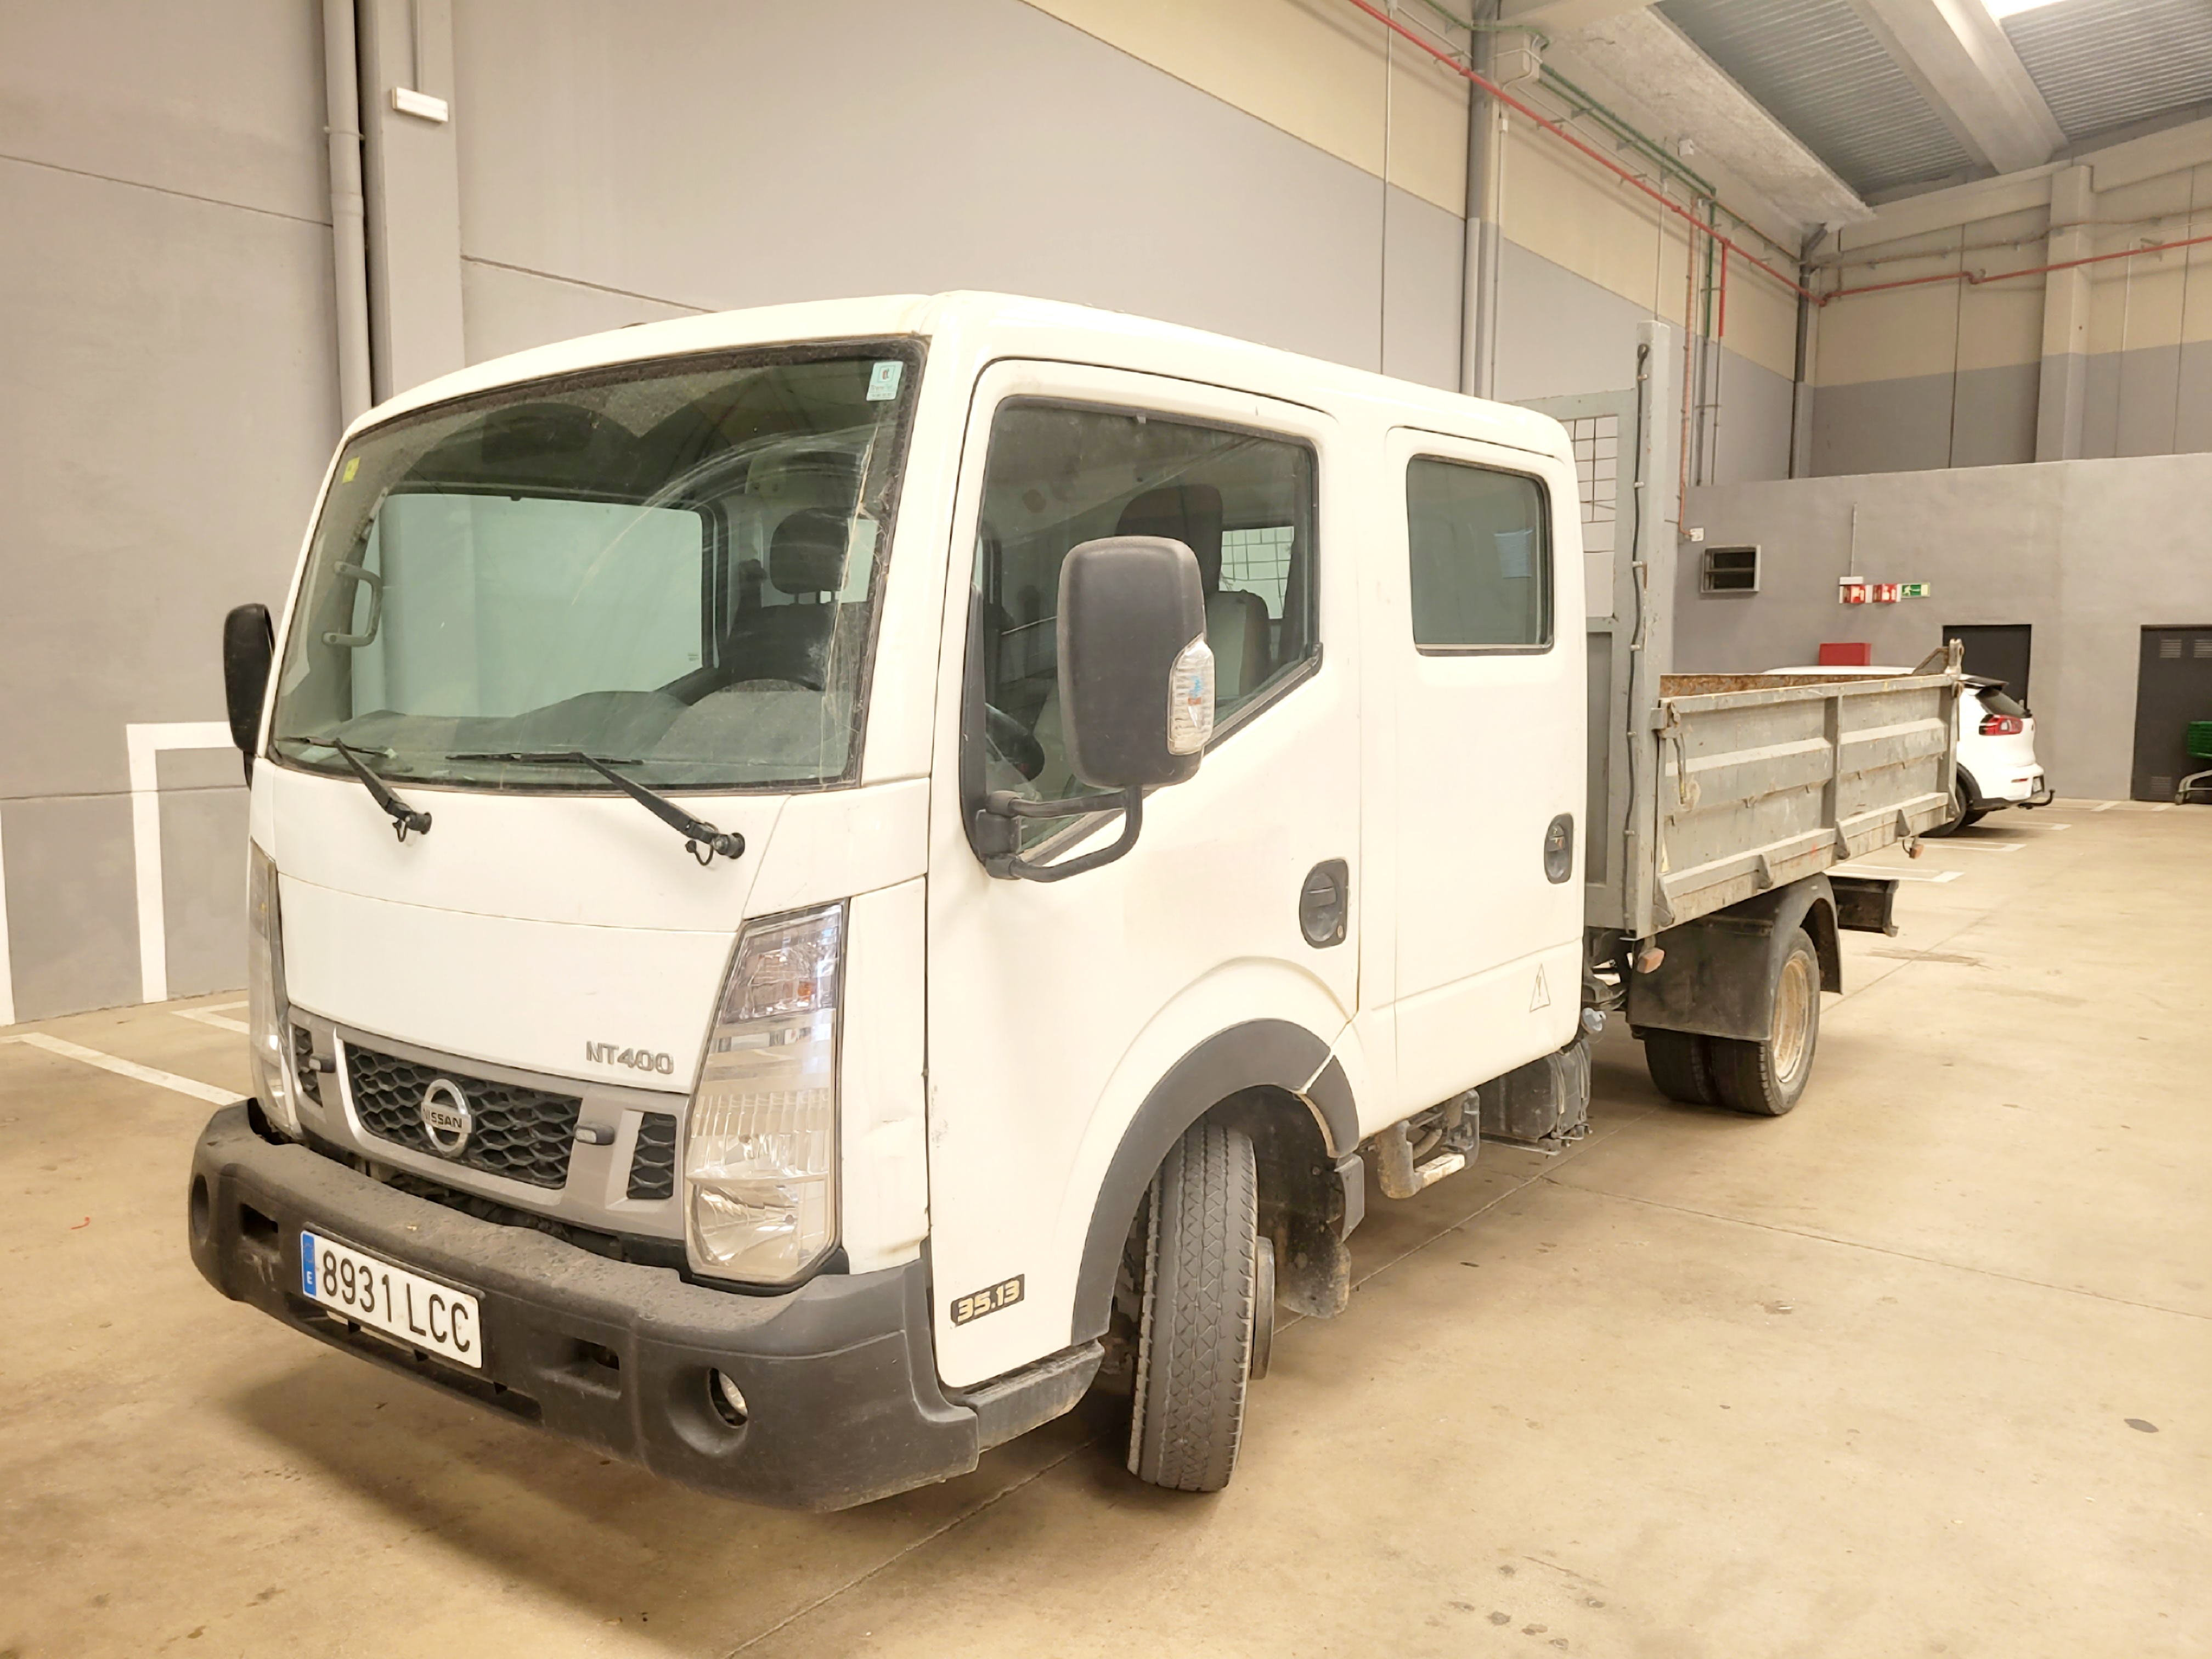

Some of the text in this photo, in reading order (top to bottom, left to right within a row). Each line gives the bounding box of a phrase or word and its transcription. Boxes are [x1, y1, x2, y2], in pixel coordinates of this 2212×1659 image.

[586, 1040, 674, 1075] NT400
[423, 1107, 462, 1128] NISSAN
[306, 1271, 313, 1285] E
[323, 1250, 470, 1352] 8931 LCC
[957, 1280, 1020, 1323] 35.13
